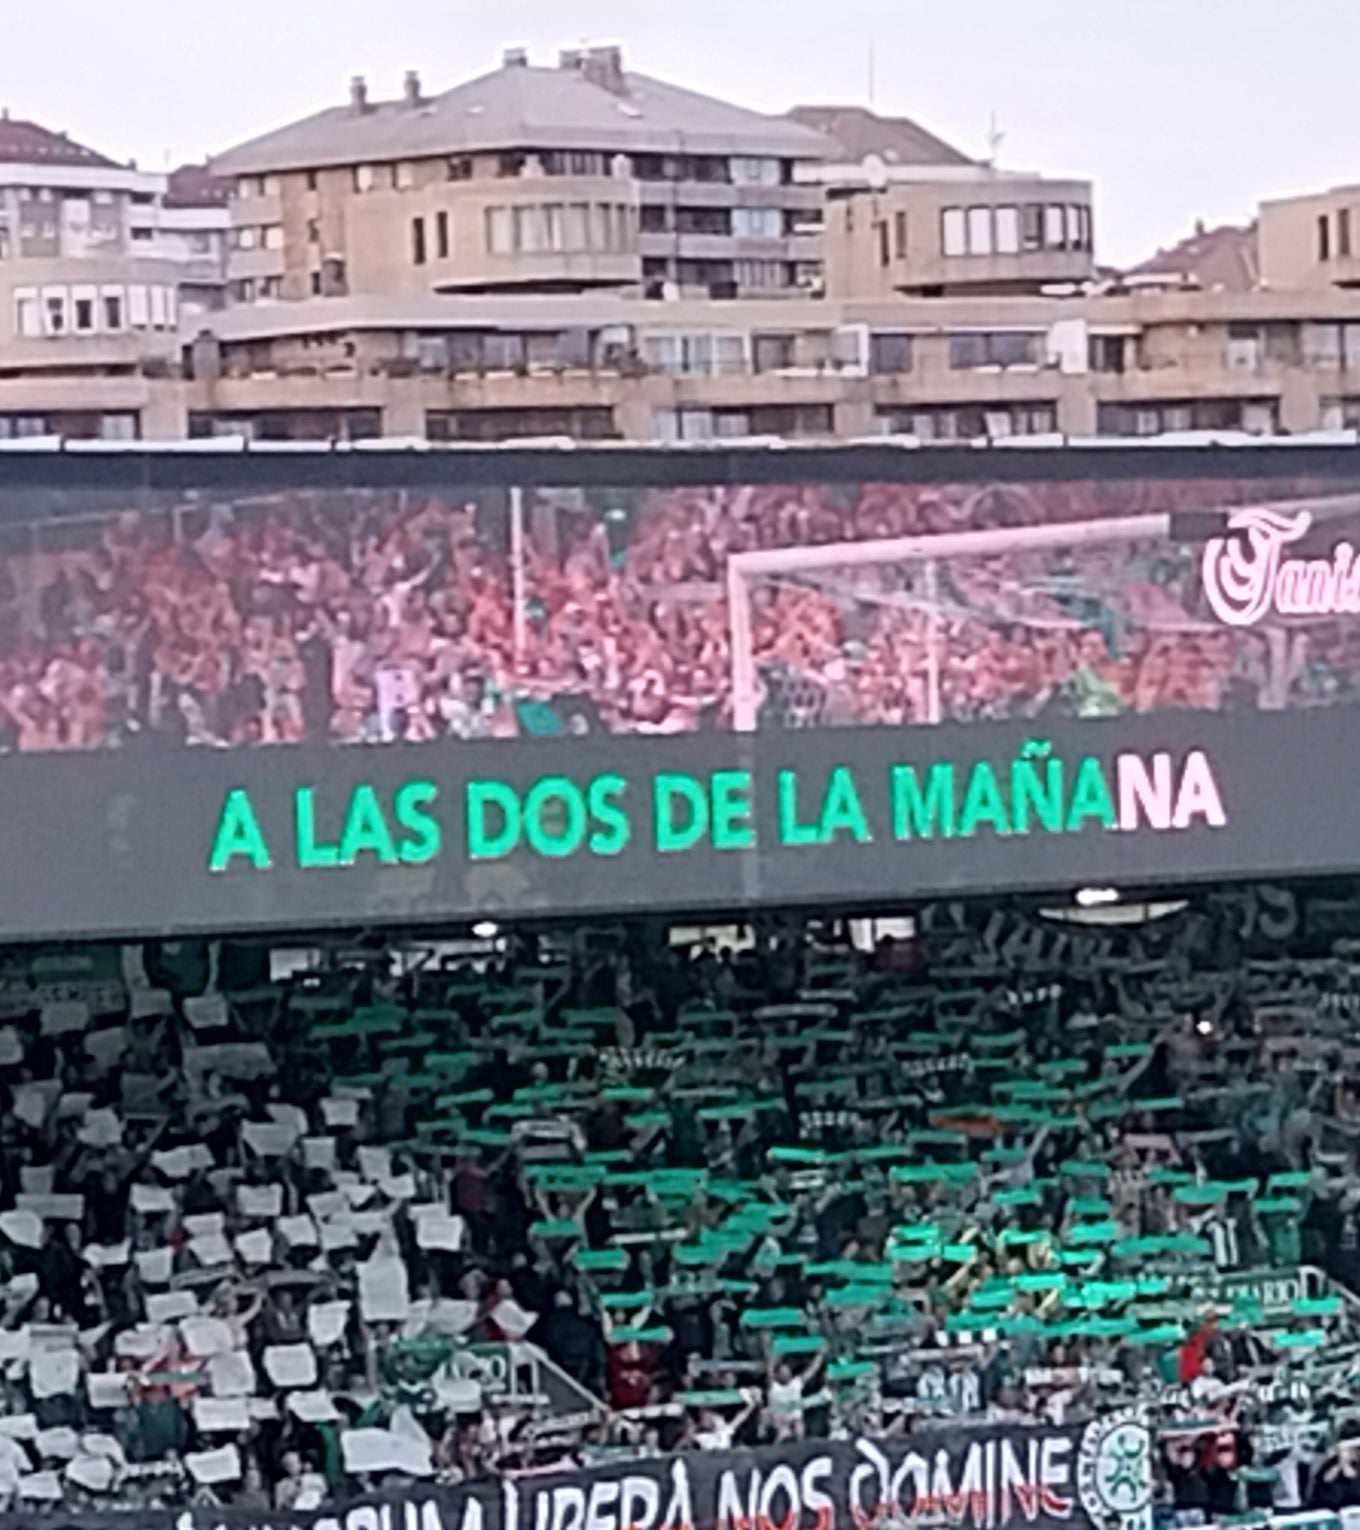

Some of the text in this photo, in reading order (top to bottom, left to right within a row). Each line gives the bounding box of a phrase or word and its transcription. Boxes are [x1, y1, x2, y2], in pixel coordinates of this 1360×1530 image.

[208, 738, 1226, 871] A LAS DOS DE LA MAÑANA
